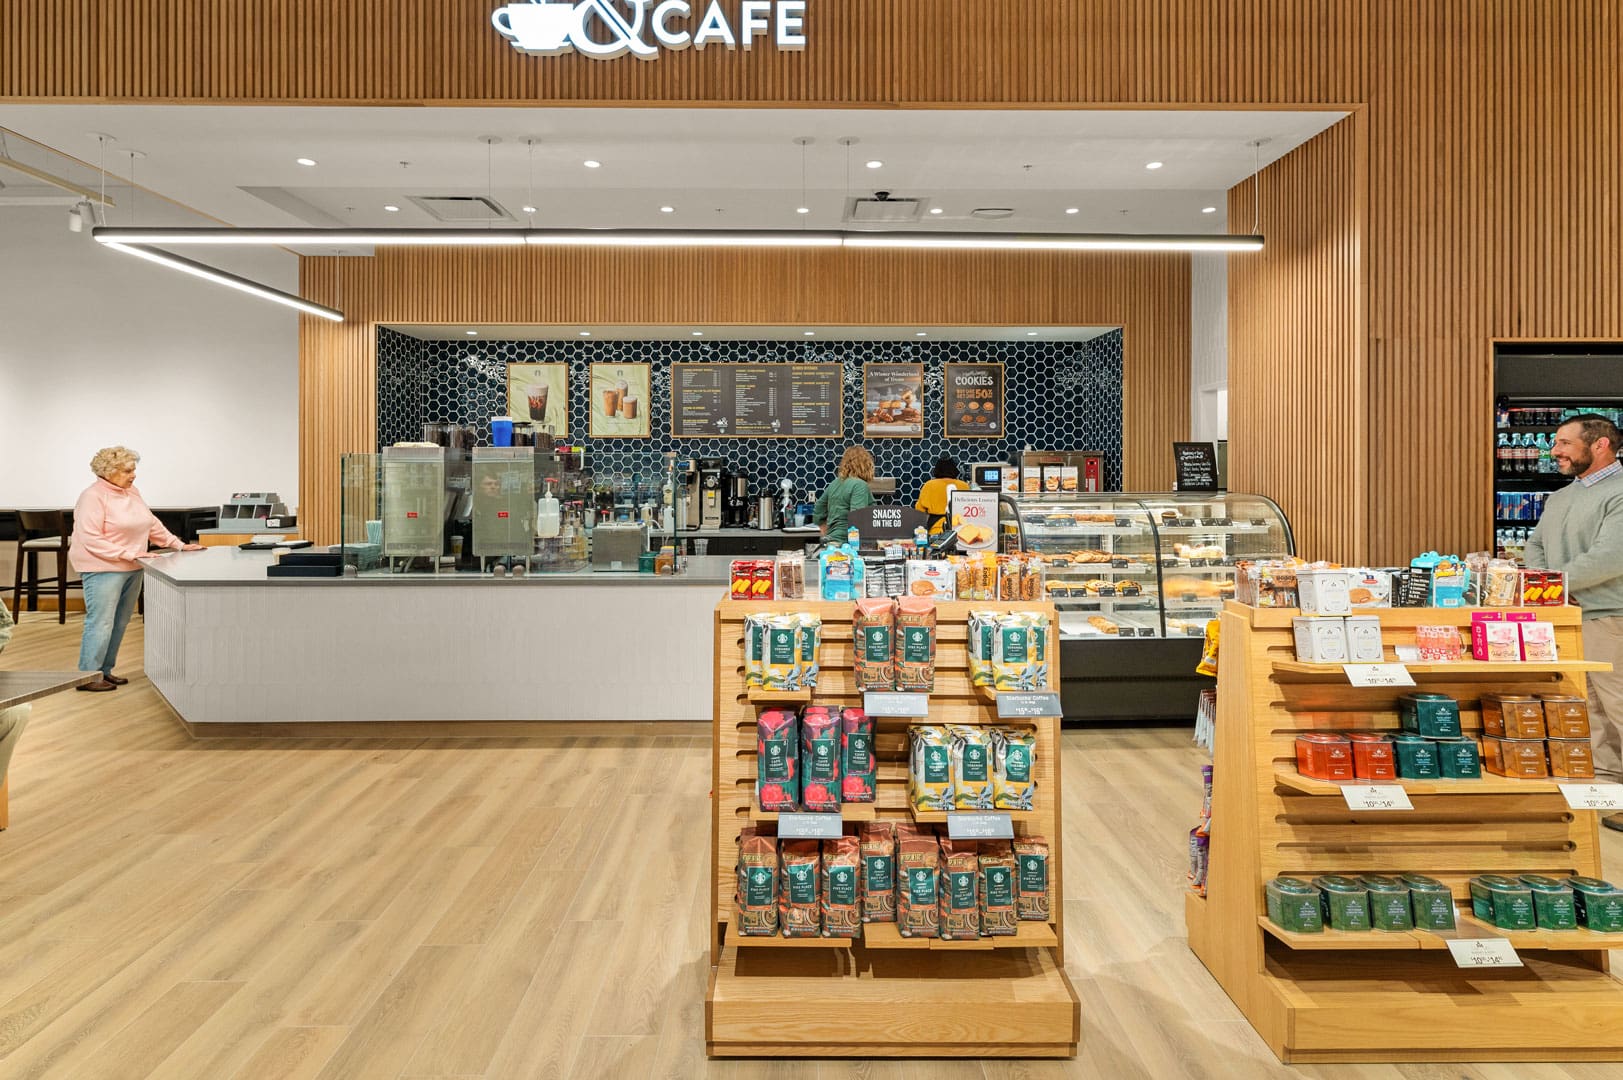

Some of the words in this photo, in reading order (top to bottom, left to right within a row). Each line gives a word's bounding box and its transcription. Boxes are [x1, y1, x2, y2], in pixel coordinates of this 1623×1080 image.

[652, 0, 807, 50] CAFE
[955, 376, 994, 386] COOKIES
[872, 509, 902, 519] SNACKS
[963, 506, 986, 518] 20%
[872, 520, 880, 528] ON
[882, 520, 893, 528] THE
[894, 520, 902, 528] GO
